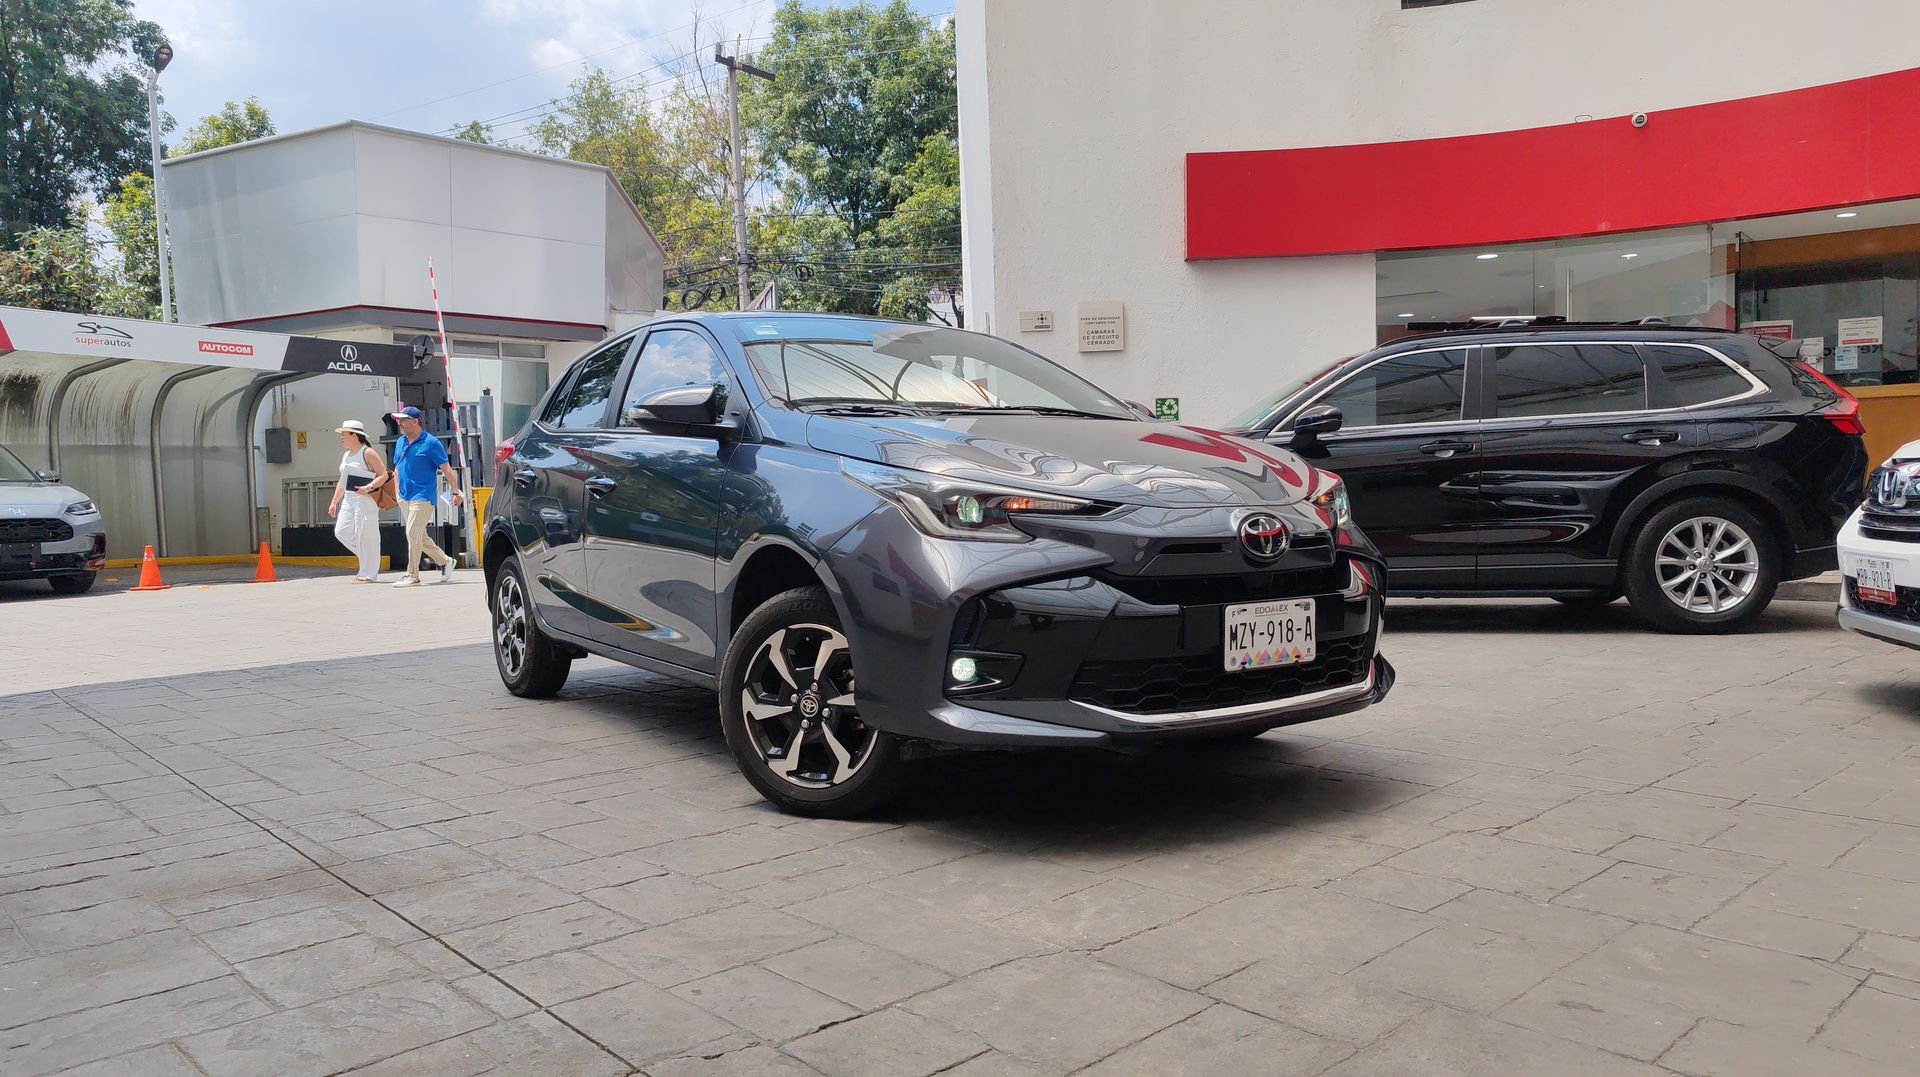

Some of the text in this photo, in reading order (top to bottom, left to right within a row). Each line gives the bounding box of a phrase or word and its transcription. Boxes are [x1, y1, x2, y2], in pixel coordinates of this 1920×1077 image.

[75, 336, 132, 348] superautos
[200, 342, 252, 355] AUTOCOM
[327, 361, 373, 373] ACURA
[1229, 615, 1313, 652] MZY-918-A
